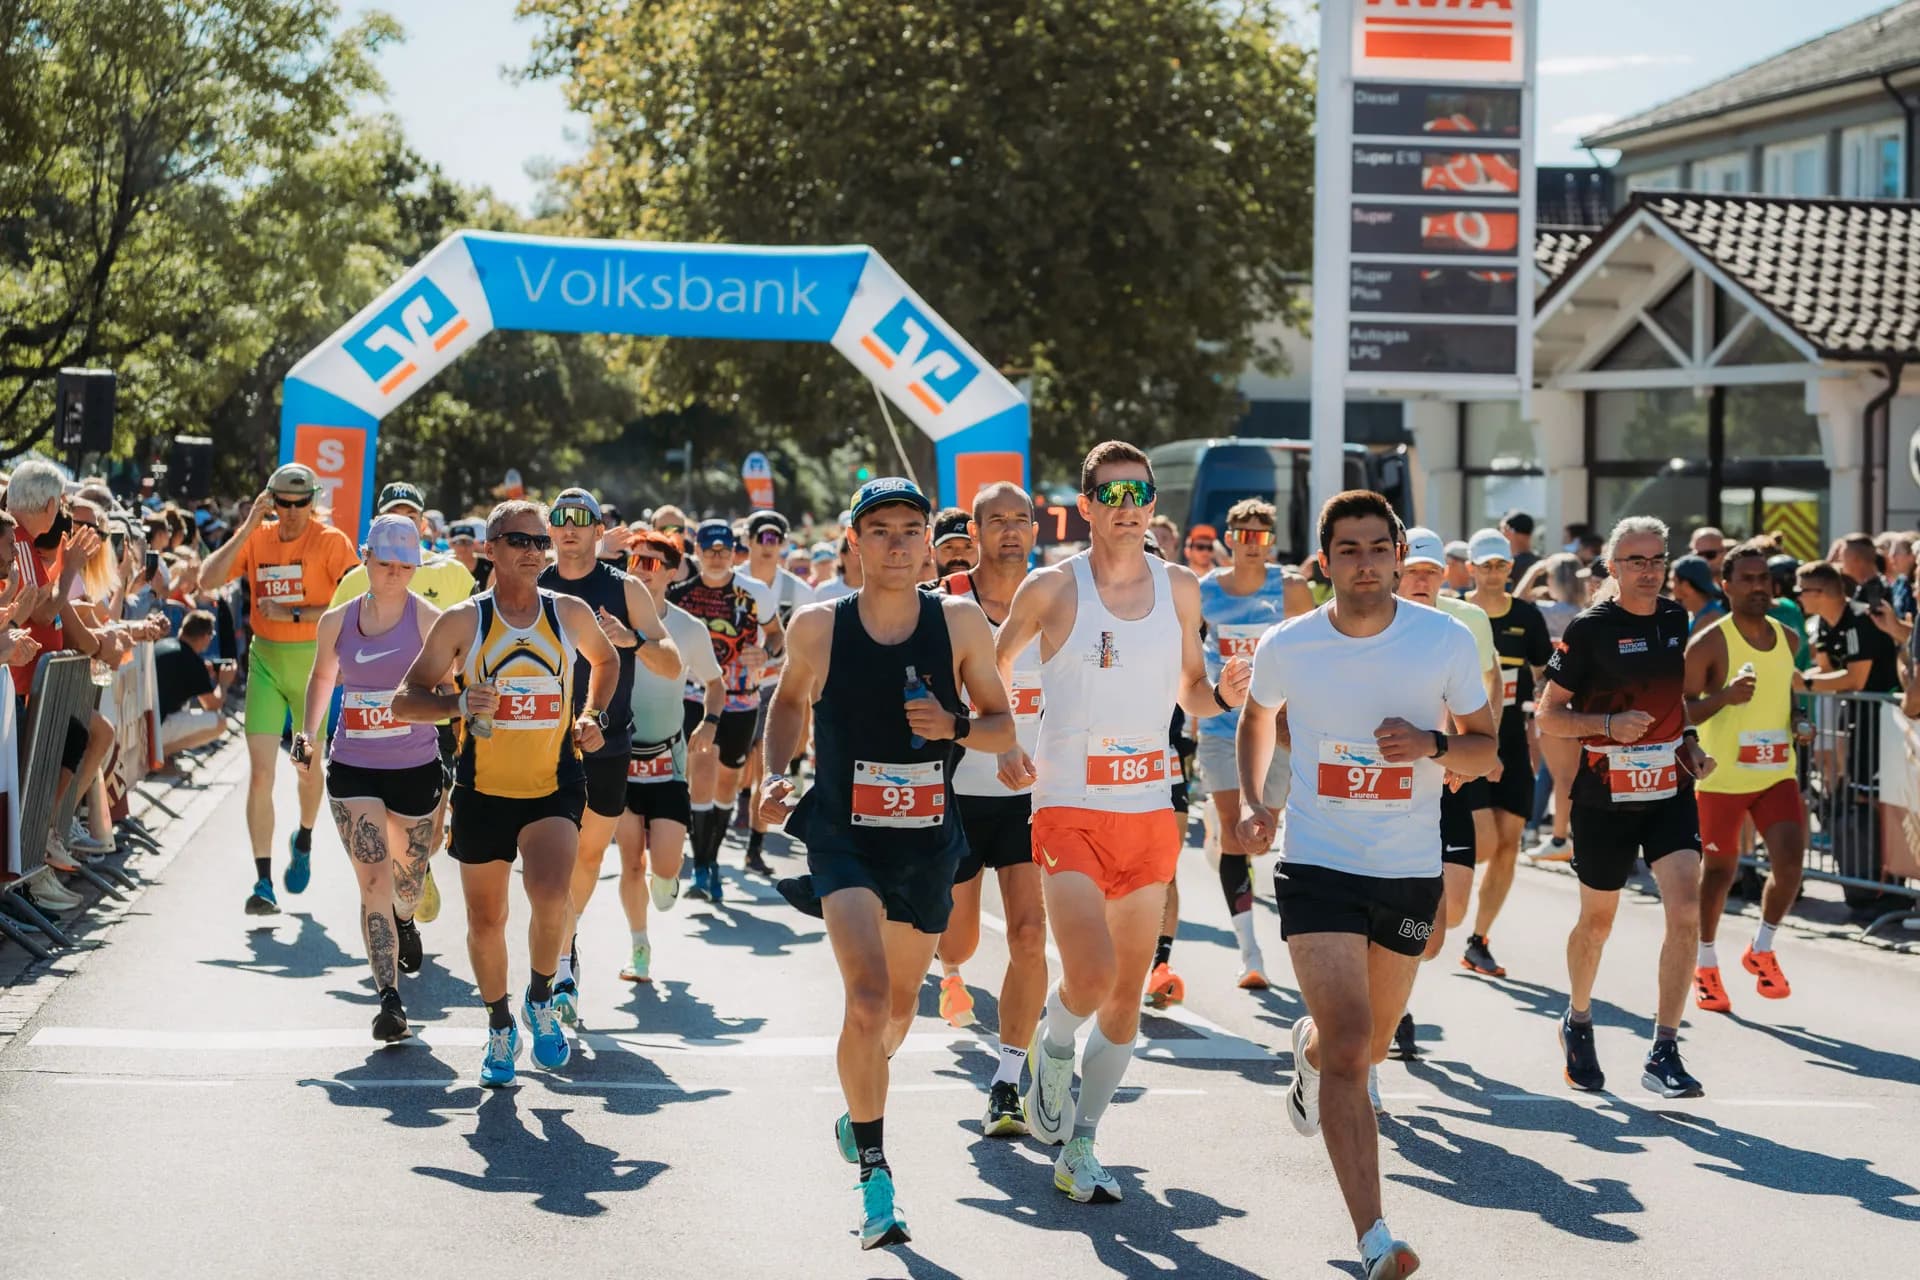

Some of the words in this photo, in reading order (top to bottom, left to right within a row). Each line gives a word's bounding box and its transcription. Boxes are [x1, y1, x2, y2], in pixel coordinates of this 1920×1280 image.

[1355, 90, 1399, 105] Diesel
[1354, 149, 1394, 167] Super
[1395, 150, 1422, 165] E10
[1353, 208, 1393, 226] Super
[1353, 267, 1392, 285] Super
[515, 256, 820, 316] Volksbank
[1352, 286, 1382, 301] Plus
[1351, 327, 1410, 345] Autogas
[1350, 345, 1381, 360] LPG
[1047, 506, 1067, 541] 7
[265, 580, 290, 596] 184
[1229, 639, 1256, 654] 121
[510, 695, 537, 716] 54
[359, 708, 395, 727] 104
[1755, 745, 1775, 761] 33
[630, 759, 657, 774] 151
[1108, 757, 1149, 781] 186
[1347, 767, 1383, 792] 97
[1627, 768, 1663, 788] 107
[882, 786, 916, 810] 93
[1349, 791, 1380, 800] Laurenz
